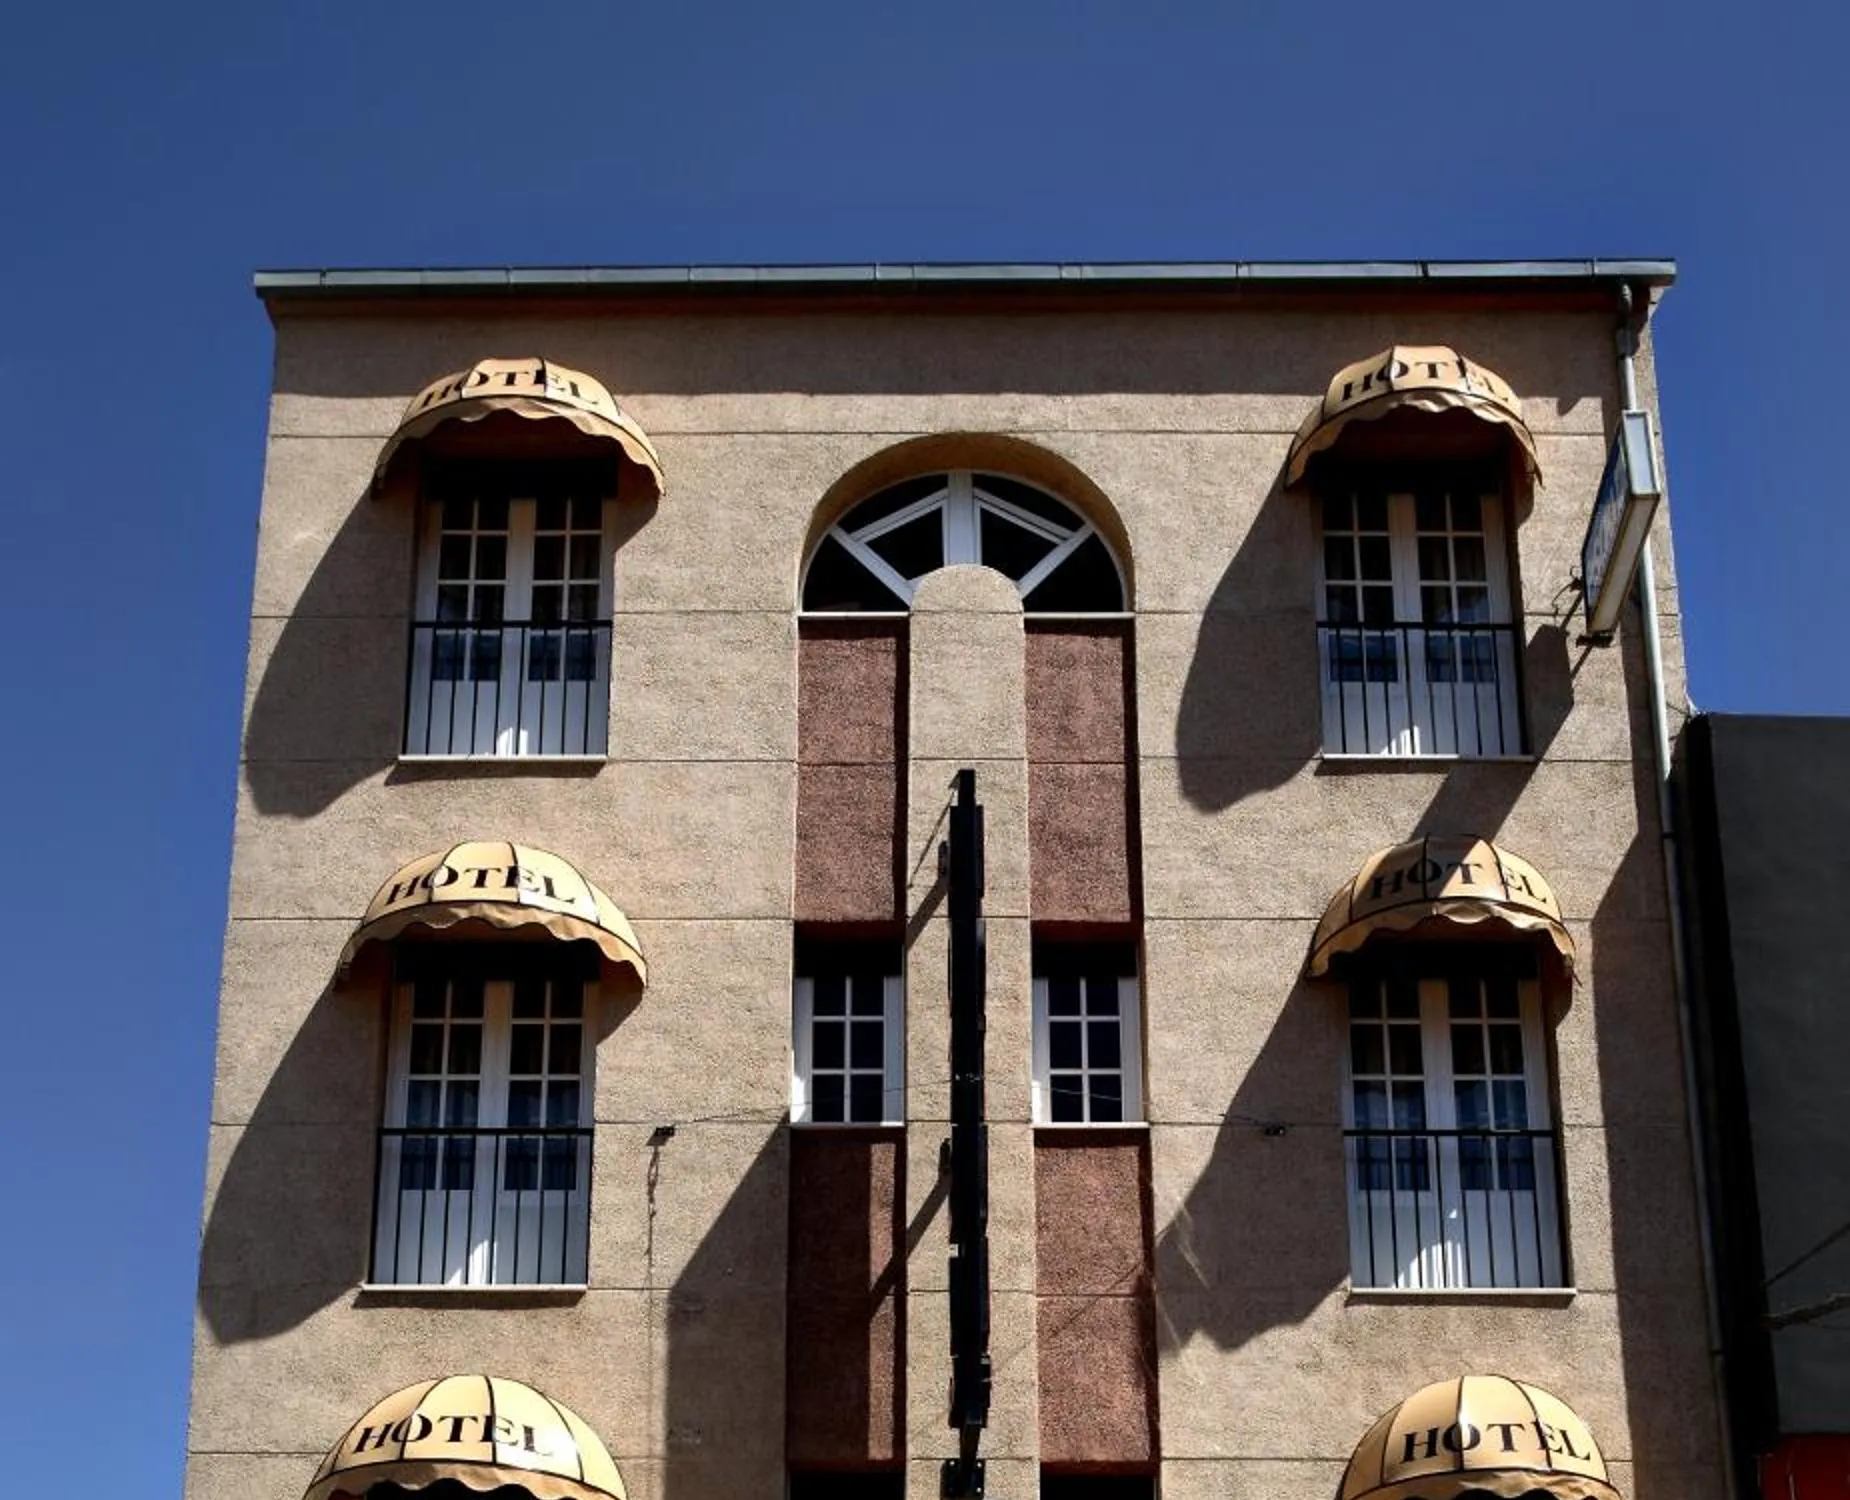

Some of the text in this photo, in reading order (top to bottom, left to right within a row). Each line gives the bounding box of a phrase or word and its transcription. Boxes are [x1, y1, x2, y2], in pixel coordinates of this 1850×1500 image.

[421, 369, 600, 406] HOTEL
[1341, 357, 1509, 402] HOTEL
[385, 864, 575, 905] HOTEL
[1370, 858, 1547, 904] HOTEL
[353, 1413, 553, 1456] HOTEL
[1400, 1419, 1592, 1464] HOTEL
